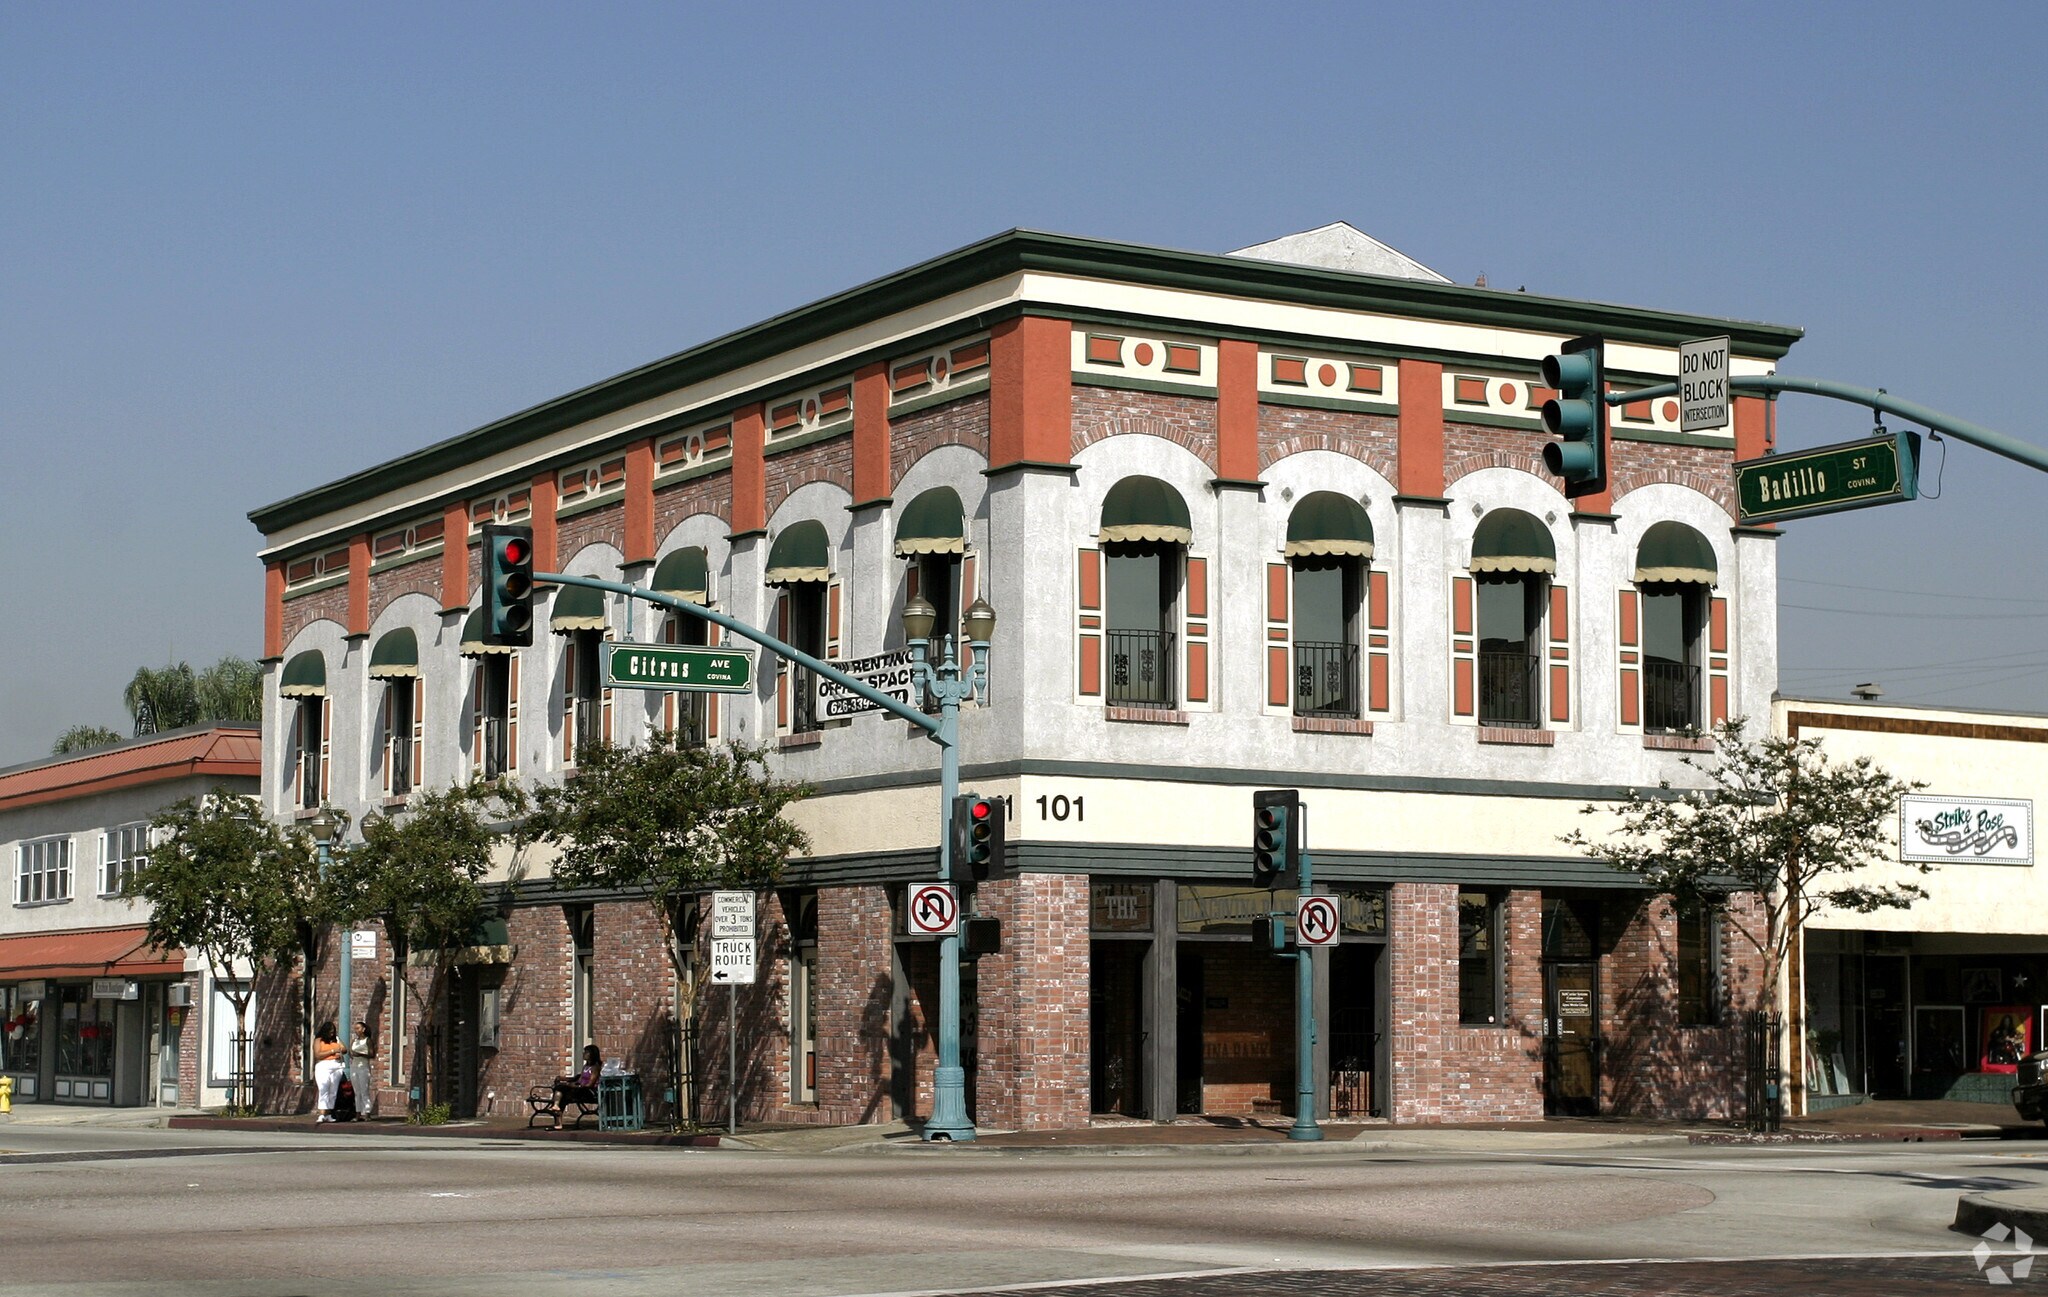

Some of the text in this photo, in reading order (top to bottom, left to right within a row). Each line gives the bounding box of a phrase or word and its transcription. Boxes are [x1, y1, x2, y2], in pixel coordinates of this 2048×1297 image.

[1683, 349, 1725, 374] DO NOT
[1684, 378, 1724, 403] BLOCK
[1684, 404, 1725, 423] INTERSECTION
[1759, 457, 1867, 503] Badillo ST
[1847, 477, 1877, 489] COVINA
[629, 655, 731, 678] Citrus AVE
[706, 673, 732, 681] COVINA
[1036, 794, 1084, 822] 101
[1934, 807, 1972, 833] Strike
[1976, 808, 2005, 831] Pose
[722, 905, 746, 913] VEHICLES
[1104, 895, 1138, 920] THE
[714, 914, 753, 925] OVER 3 TONS
[716, 942, 751, 953] TRUCK
[715, 955, 751, 966] ROUTE
